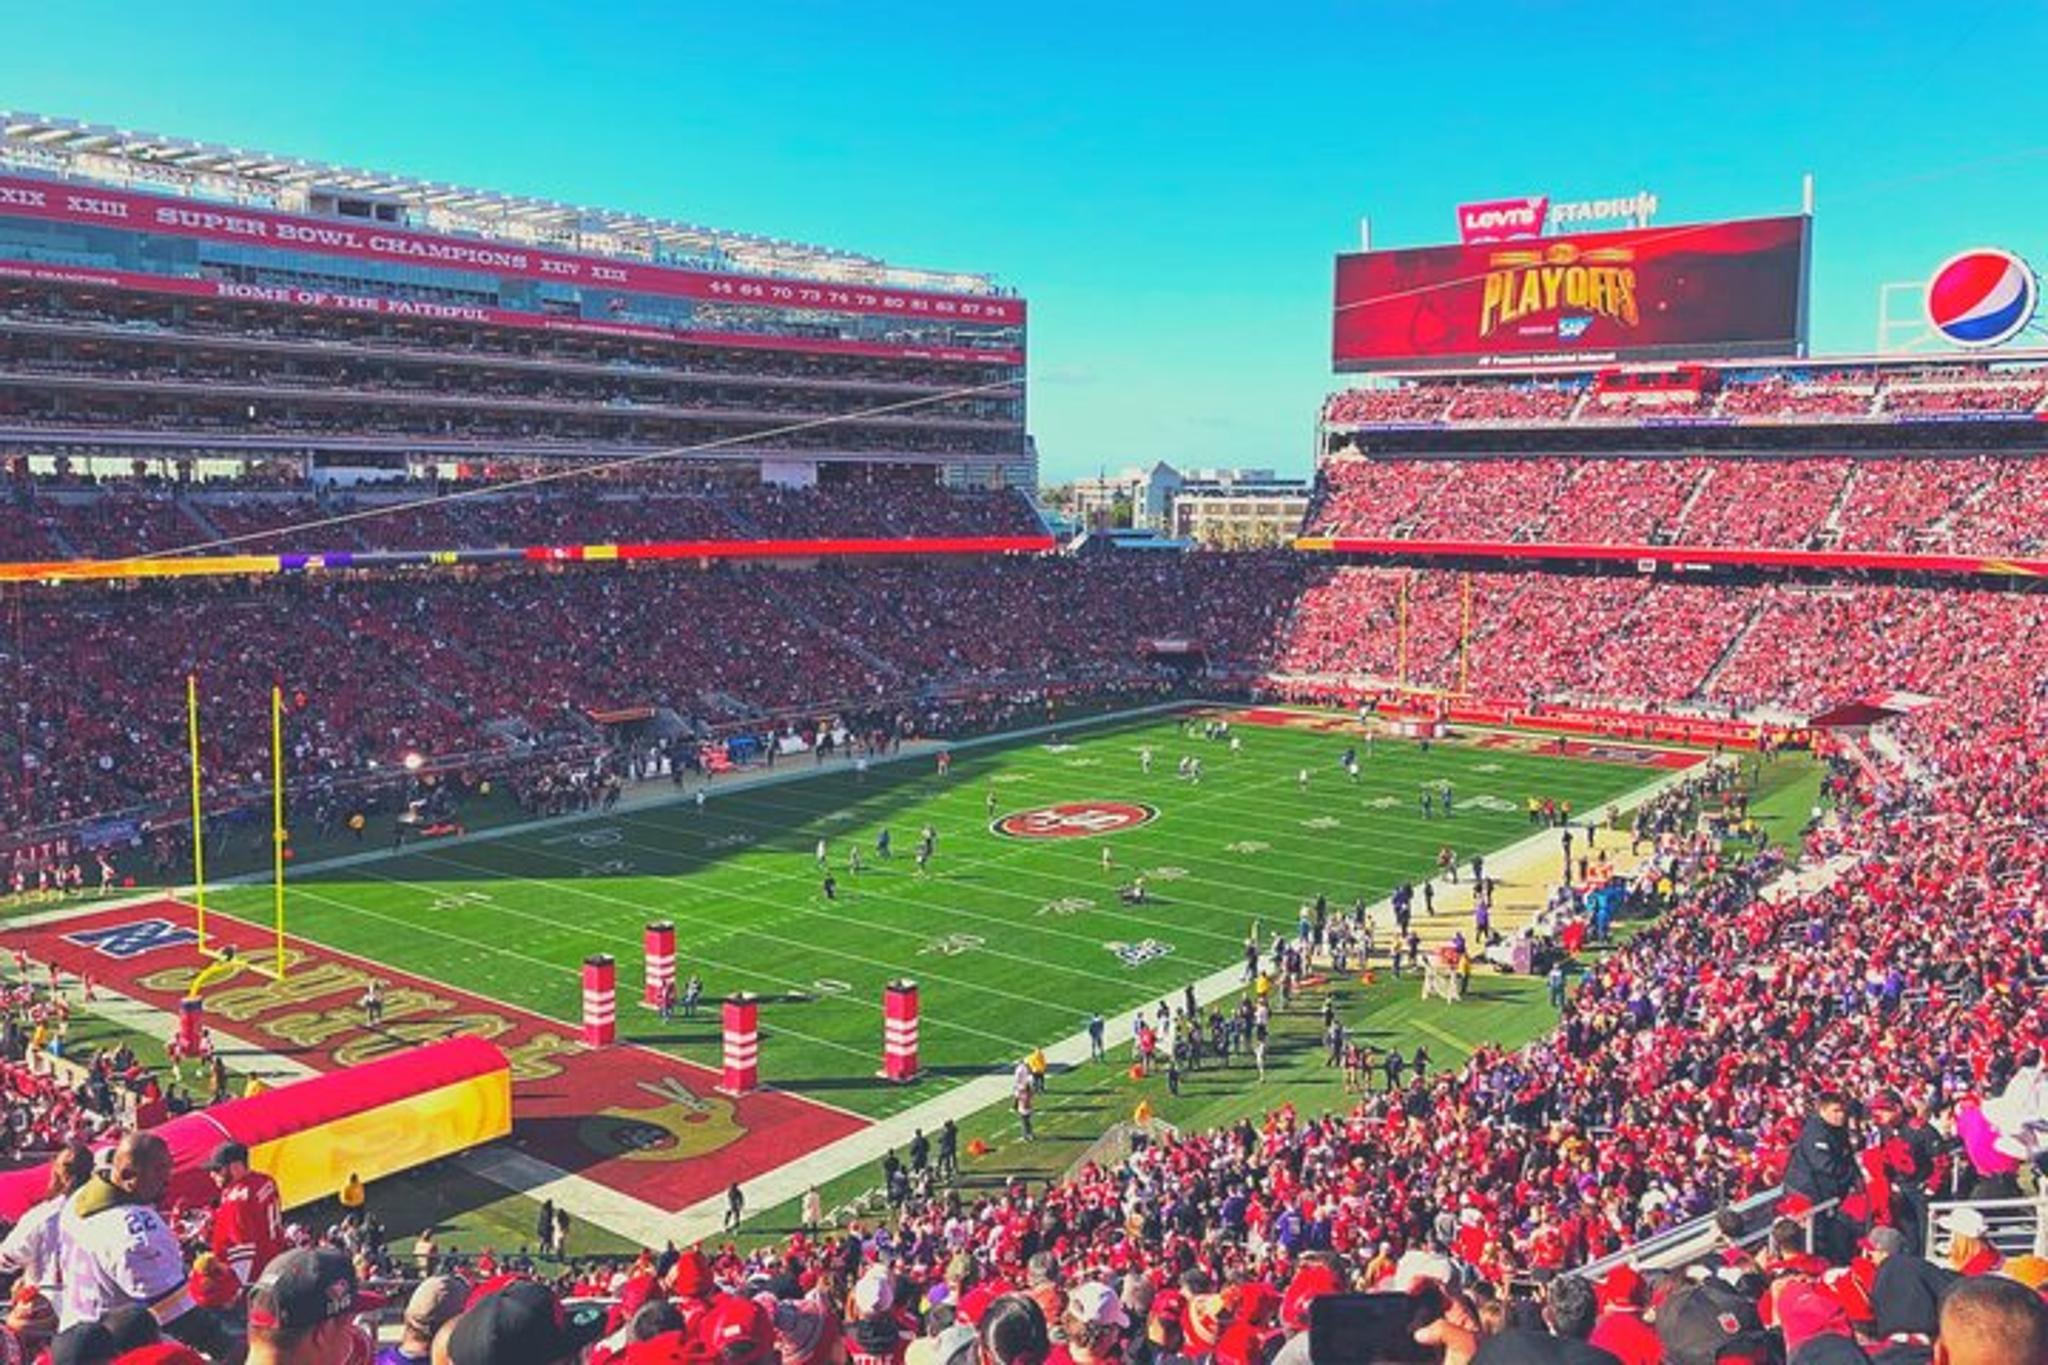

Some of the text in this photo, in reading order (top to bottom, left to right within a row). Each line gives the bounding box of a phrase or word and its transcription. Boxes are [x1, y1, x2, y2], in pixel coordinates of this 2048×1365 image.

[67, 195, 128, 218] XXIII
[1552, 196, 1657, 221] STADIUM
[156, 207, 528, 269] SUPER BOWL CHAMPIONS
[217, 283, 491, 321] HOME OF THE FAITHFUL
[771, 286, 793, 299] 70
[800, 288, 822, 301] 73
[828, 290, 849, 304] 74
[1480, 266, 1640, 337] PLAYOFFS
